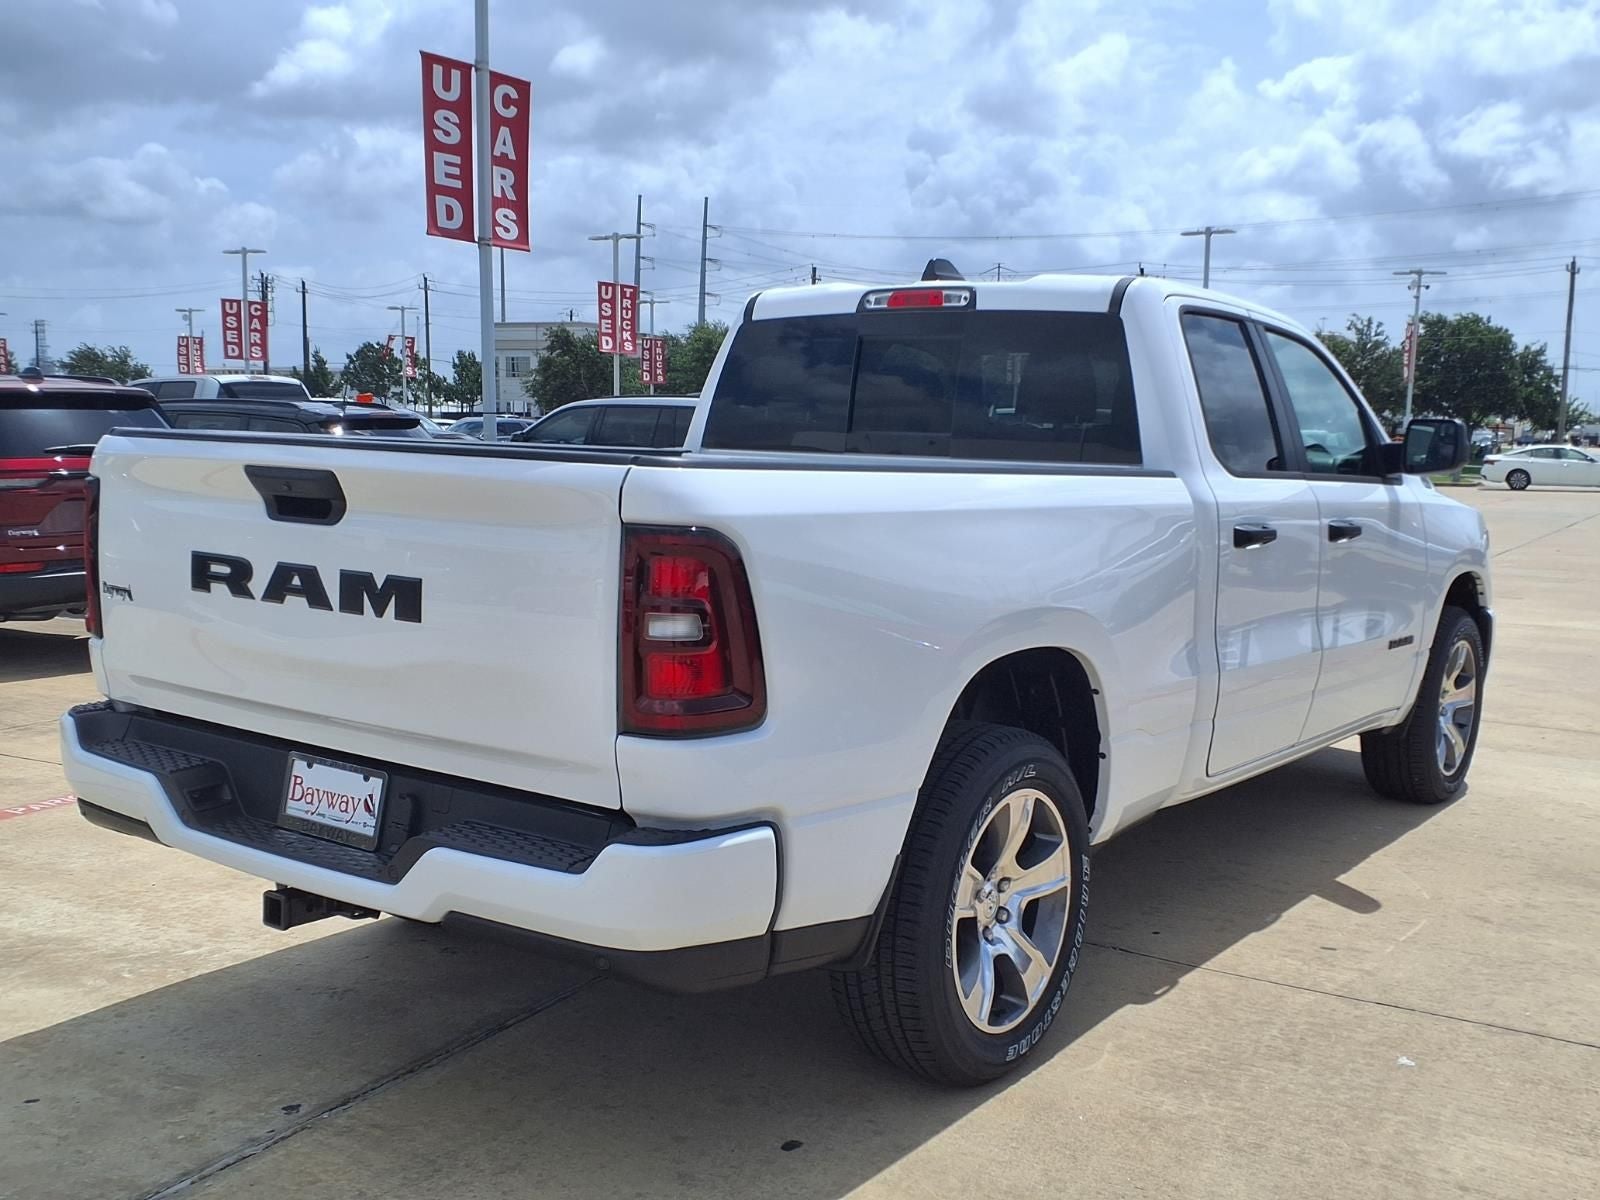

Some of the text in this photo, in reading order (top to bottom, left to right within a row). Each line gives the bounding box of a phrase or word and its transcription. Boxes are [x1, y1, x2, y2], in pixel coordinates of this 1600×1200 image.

[432, 63, 464, 230] USED
[493, 84, 519, 241] CARS
[224, 301, 240, 357] USED
[250, 304, 263, 358] CARS
[601, 285, 613, 350] USED
[622, 288, 634, 351] TRUCKS
[179, 337, 188, 373] USED
[193, 338, 202, 373] TRUCKS
[405, 338, 413, 375] CARS
[643, 339, 651, 381] USED
[656, 340, 664, 382] TRUCKS
[191, 550, 423, 624] RAM
[289, 774, 362, 825] Bayway
[1006, 854, 1091, 1062] BRIDGESTONE
